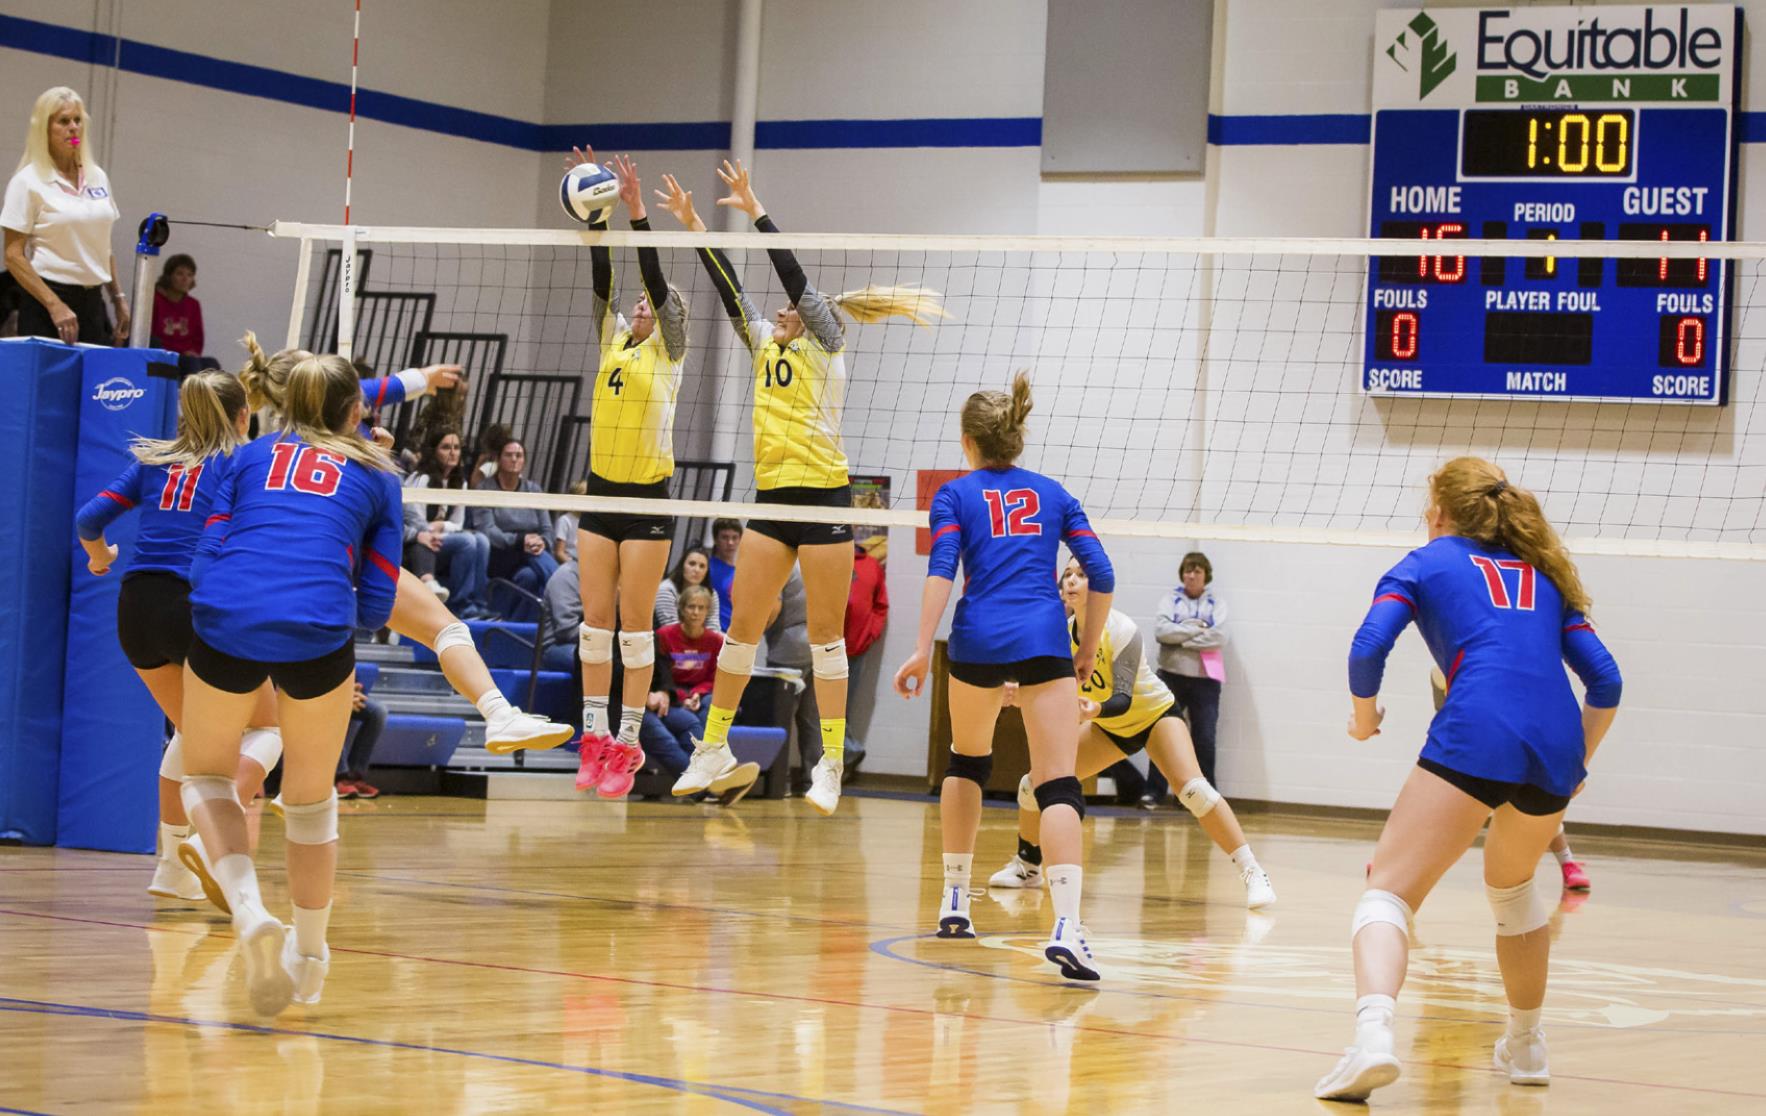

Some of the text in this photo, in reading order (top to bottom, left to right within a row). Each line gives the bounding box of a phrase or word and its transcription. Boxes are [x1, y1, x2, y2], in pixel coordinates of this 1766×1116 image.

[1478, 8, 1722, 79] Equitable
[1504, 78, 1689, 98] BANK
[1528, 114, 1628, 172] 1:00
[1390, 186, 1462, 213] HOME
[1514, 203, 1576, 223] PERIOD
[1623, 186, 1709, 216] GUEST
[1420, 223, 1464, 281] 16
[1546, 234, 1556, 274] 1
[1659, 229, 1707, 281] 11
[1374, 289, 1428, 309] FOULS
[1485, 290, 1602, 312] PLAYER FOUL
[1656, 293, 1713, 314] FOULS
[1392, 313, 1417, 358] 0
[1677, 318, 1703, 364] 0
[608, 367, 623, 395] 4
[765, 359, 793, 388] 10
[1368, 368, 1423, 389] SCORE
[1506, 372, 1567, 391] MATCH
[1652, 375, 1710, 396] SCORE
[92, 383, 145, 401] Jaypro
[264, 442, 346, 497] 16
[159, 463, 204, 512] 11
[983, 487, 1042, 538] 12
[1469, 554, 1536, 611] 17
